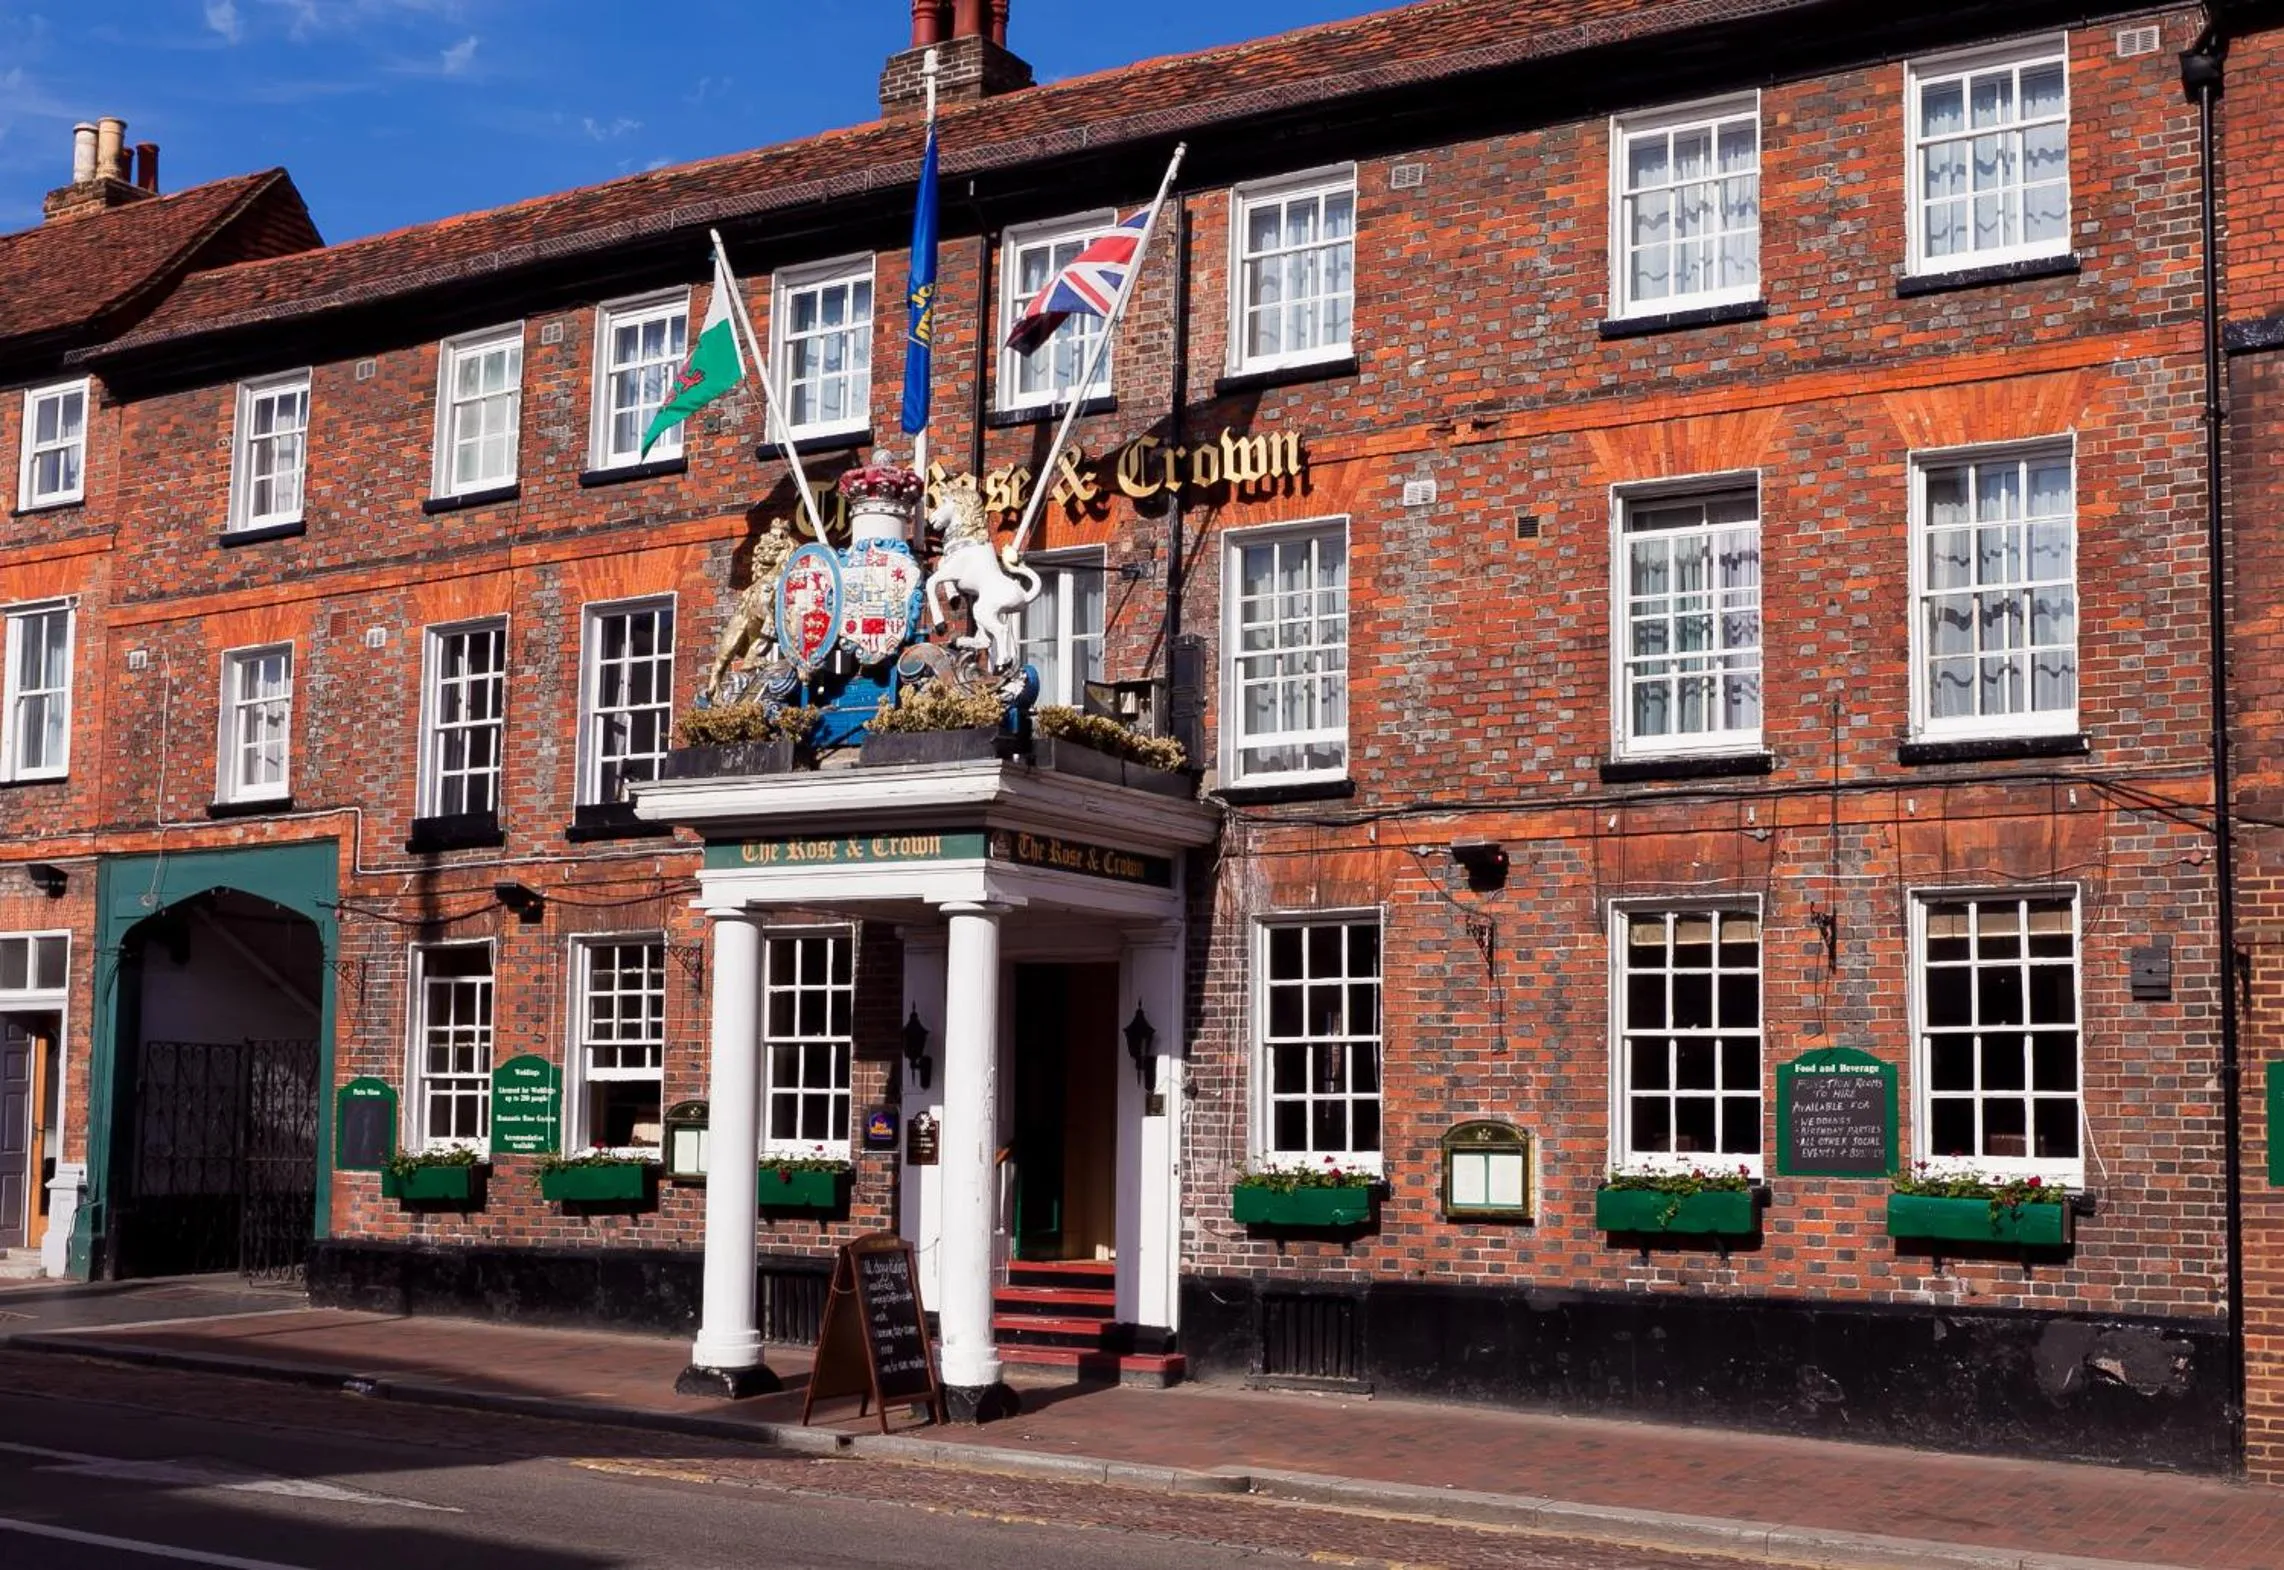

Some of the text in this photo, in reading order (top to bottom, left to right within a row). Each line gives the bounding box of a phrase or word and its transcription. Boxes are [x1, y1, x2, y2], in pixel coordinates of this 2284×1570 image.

[1051, 444, 1099, 507] &
[1117, 426, 1302, 499] Crown
[742, 835, 942, 865] The Rose & Crown
[1018, 832, 1146, 878] The Rose & Crown
[1794, 1063, 1880, 1074] Food and Beverage
[1792, 1101, 1845, 1113] AVAILABLE
